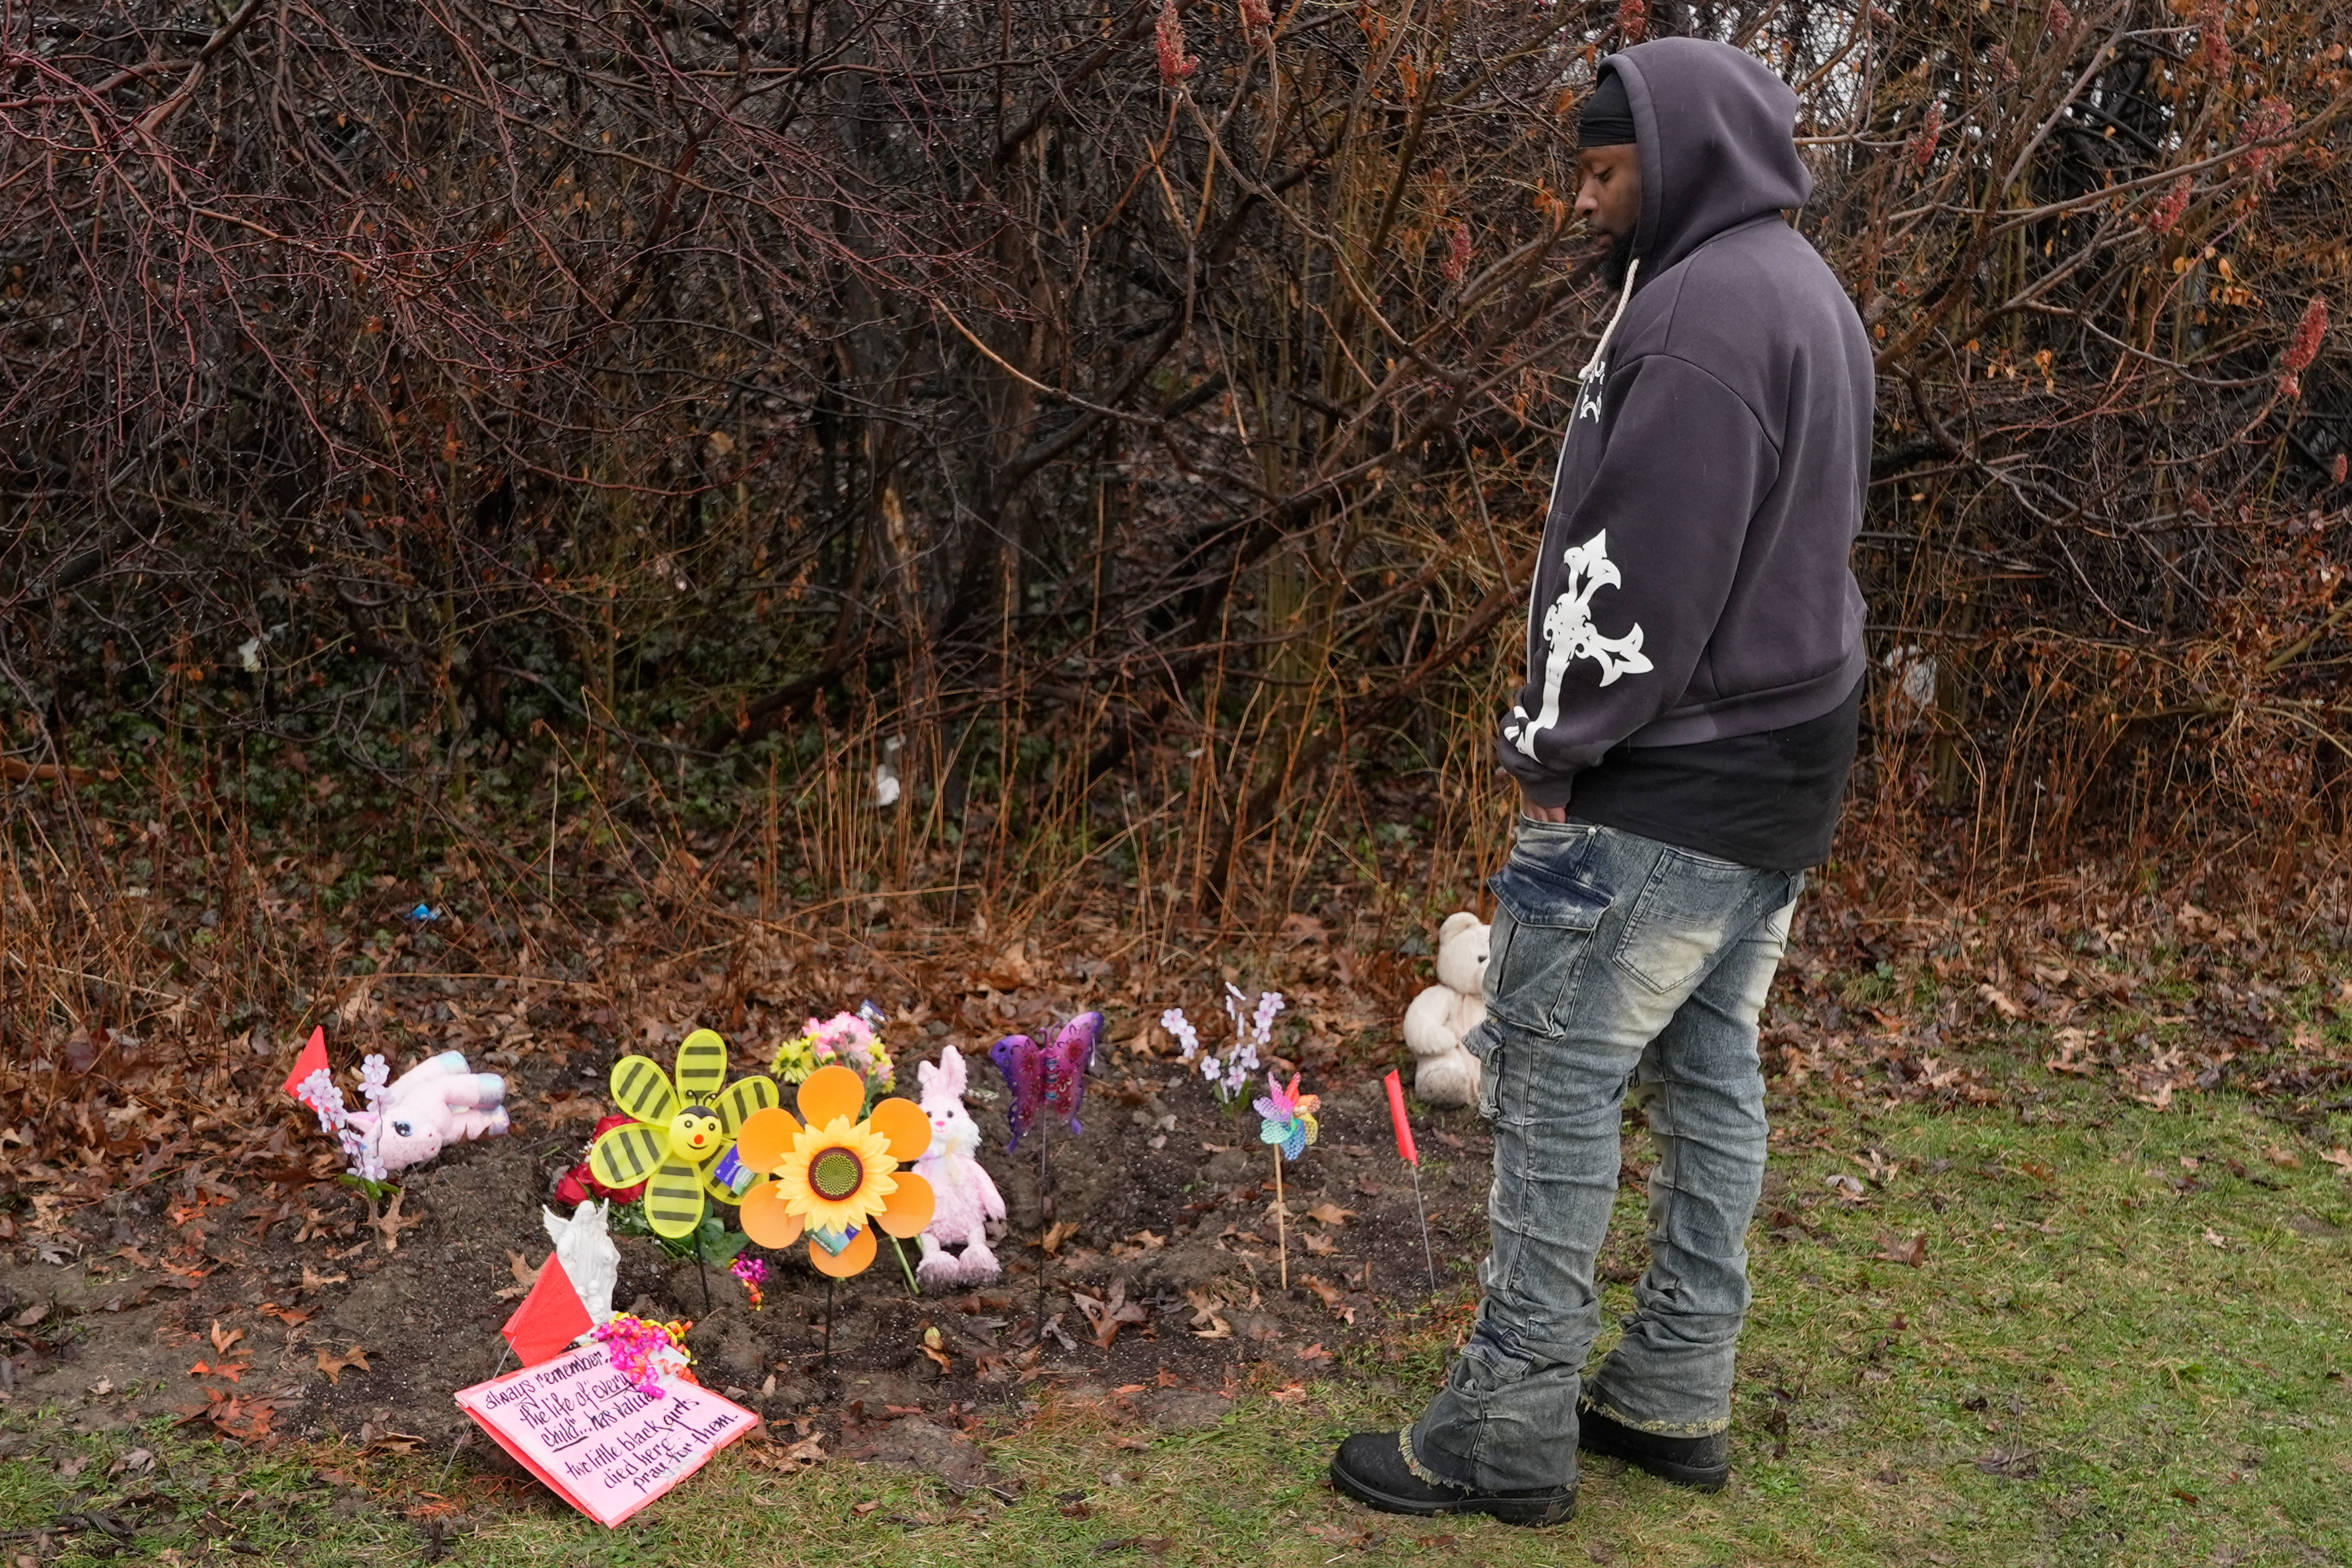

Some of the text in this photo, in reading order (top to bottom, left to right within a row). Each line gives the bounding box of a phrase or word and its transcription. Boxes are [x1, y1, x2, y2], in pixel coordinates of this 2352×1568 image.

[486, 1380, 540, 1410] always
[520, 1404, 551, 1429] the
[541, 1392, 574, 1418] life
[584, 1410, 617, 1431] has
[565, 1397, 700, 1480] two little black girls
[604, 1459, 639, 1488] died
[633, 1462, 675, 1495] pray
[666, 1443, 693, 1464] for
